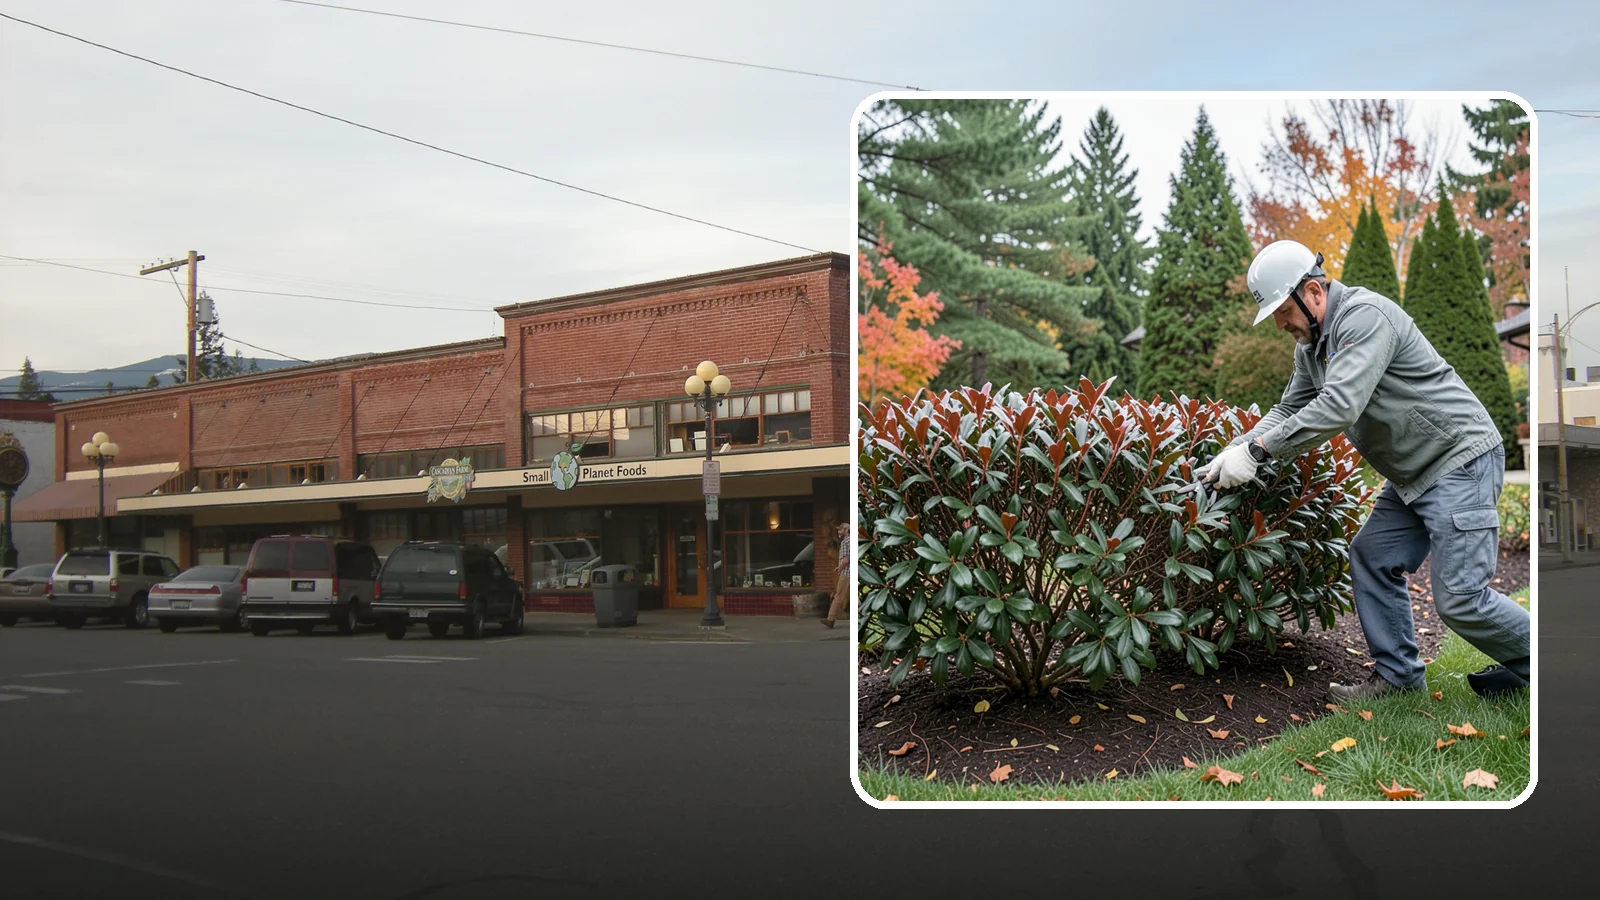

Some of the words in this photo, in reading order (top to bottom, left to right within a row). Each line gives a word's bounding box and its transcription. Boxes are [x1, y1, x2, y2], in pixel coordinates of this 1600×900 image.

[522, 470, 549, 483] Small
[582, 466, 614, 479] Planet
[616, 464, 647, 477] Foods
